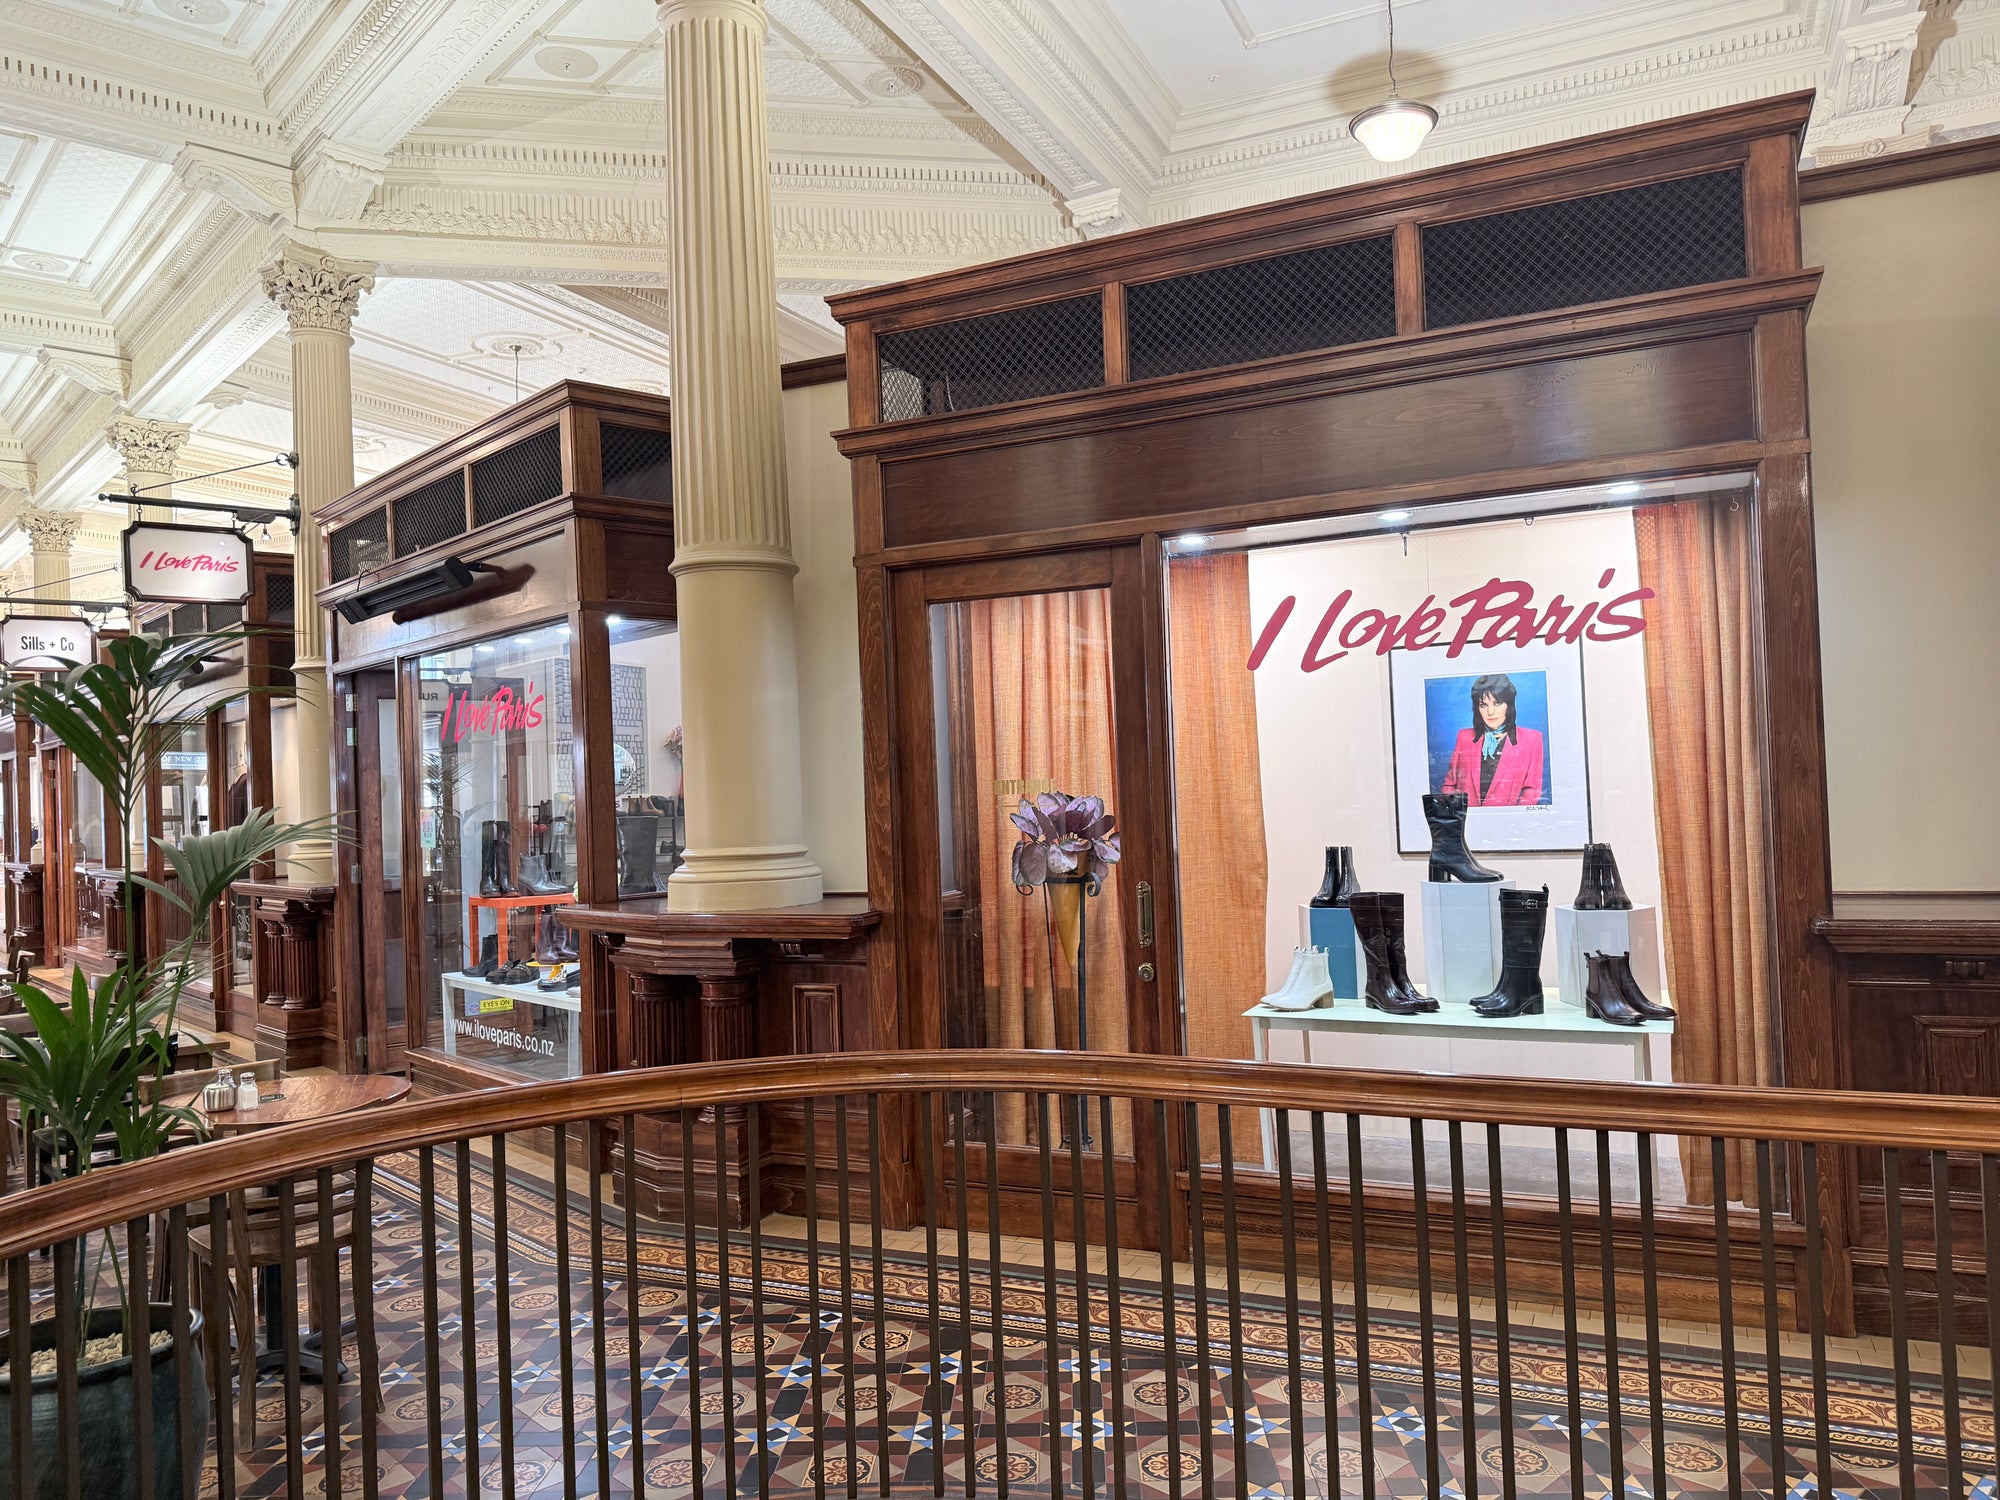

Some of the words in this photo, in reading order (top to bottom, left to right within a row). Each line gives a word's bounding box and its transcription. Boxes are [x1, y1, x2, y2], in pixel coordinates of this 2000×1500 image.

[139, 550, 154, 569] I
[154, 551, 192, 571] Love
[191, 554, 239, 573] Paris
[1246, 595, 1296, 672] I
[1300, 589, 1447, 673] Love
[1446, 567, 1656, 659] Paris
[20, 635, 46, 651] Sills
[60, 636, 75, 652] Co
[441, 692, 455, 740] I
[454, 689, 492, 744] Love
[491, 681, 545, 737] Paris
[450, 1018, 555, 1057] www.iloveparis.co.nz
